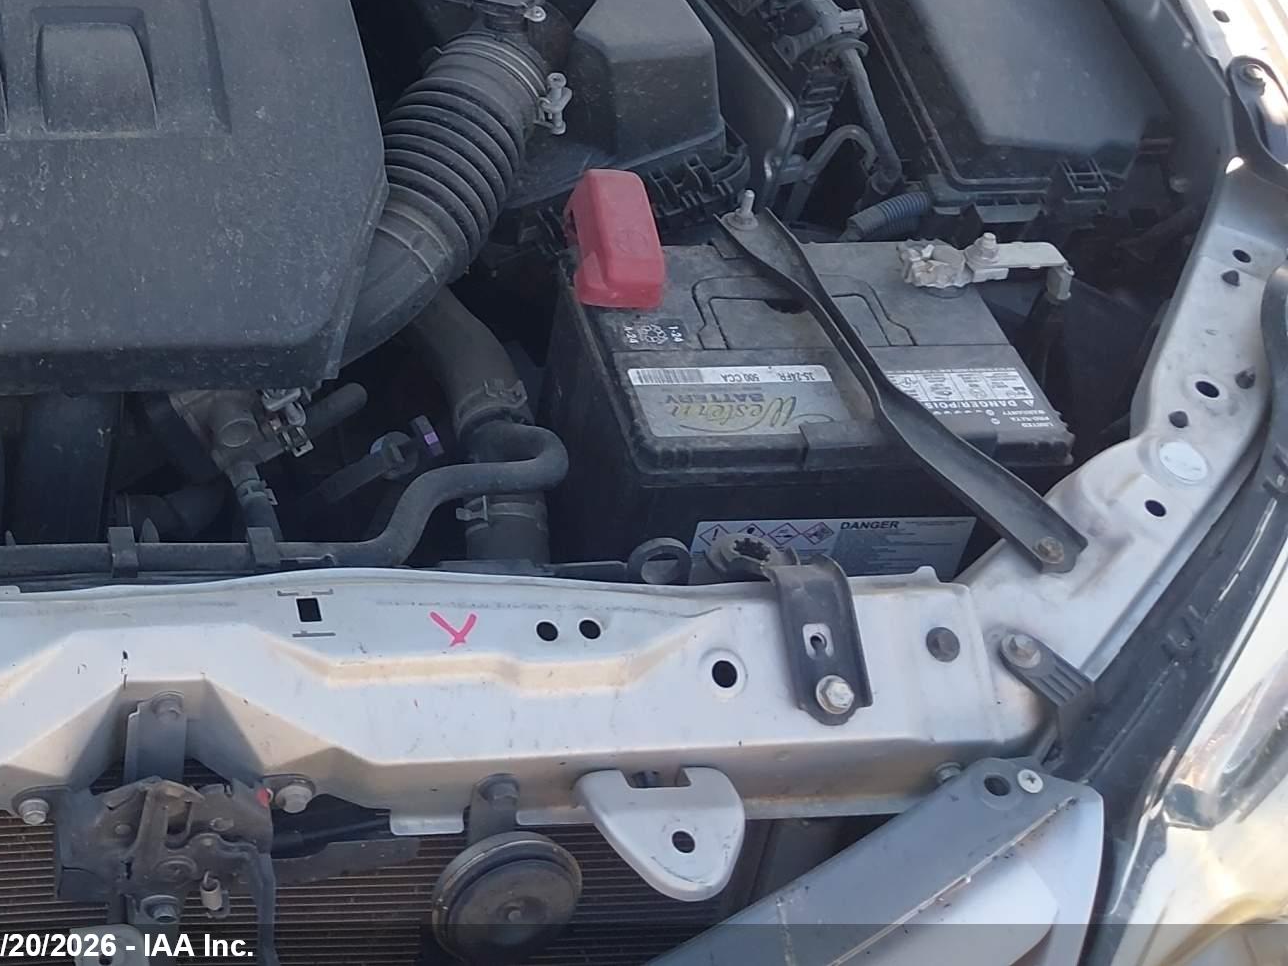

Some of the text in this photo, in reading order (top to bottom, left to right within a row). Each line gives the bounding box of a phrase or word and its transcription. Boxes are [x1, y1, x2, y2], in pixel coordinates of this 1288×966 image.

[720, 373, 743, 382] CCA
[665, 393, 765, 404] BATTERY
[671, 395, 804, 429] Western
[840, 520, 901, 530] DANGER
